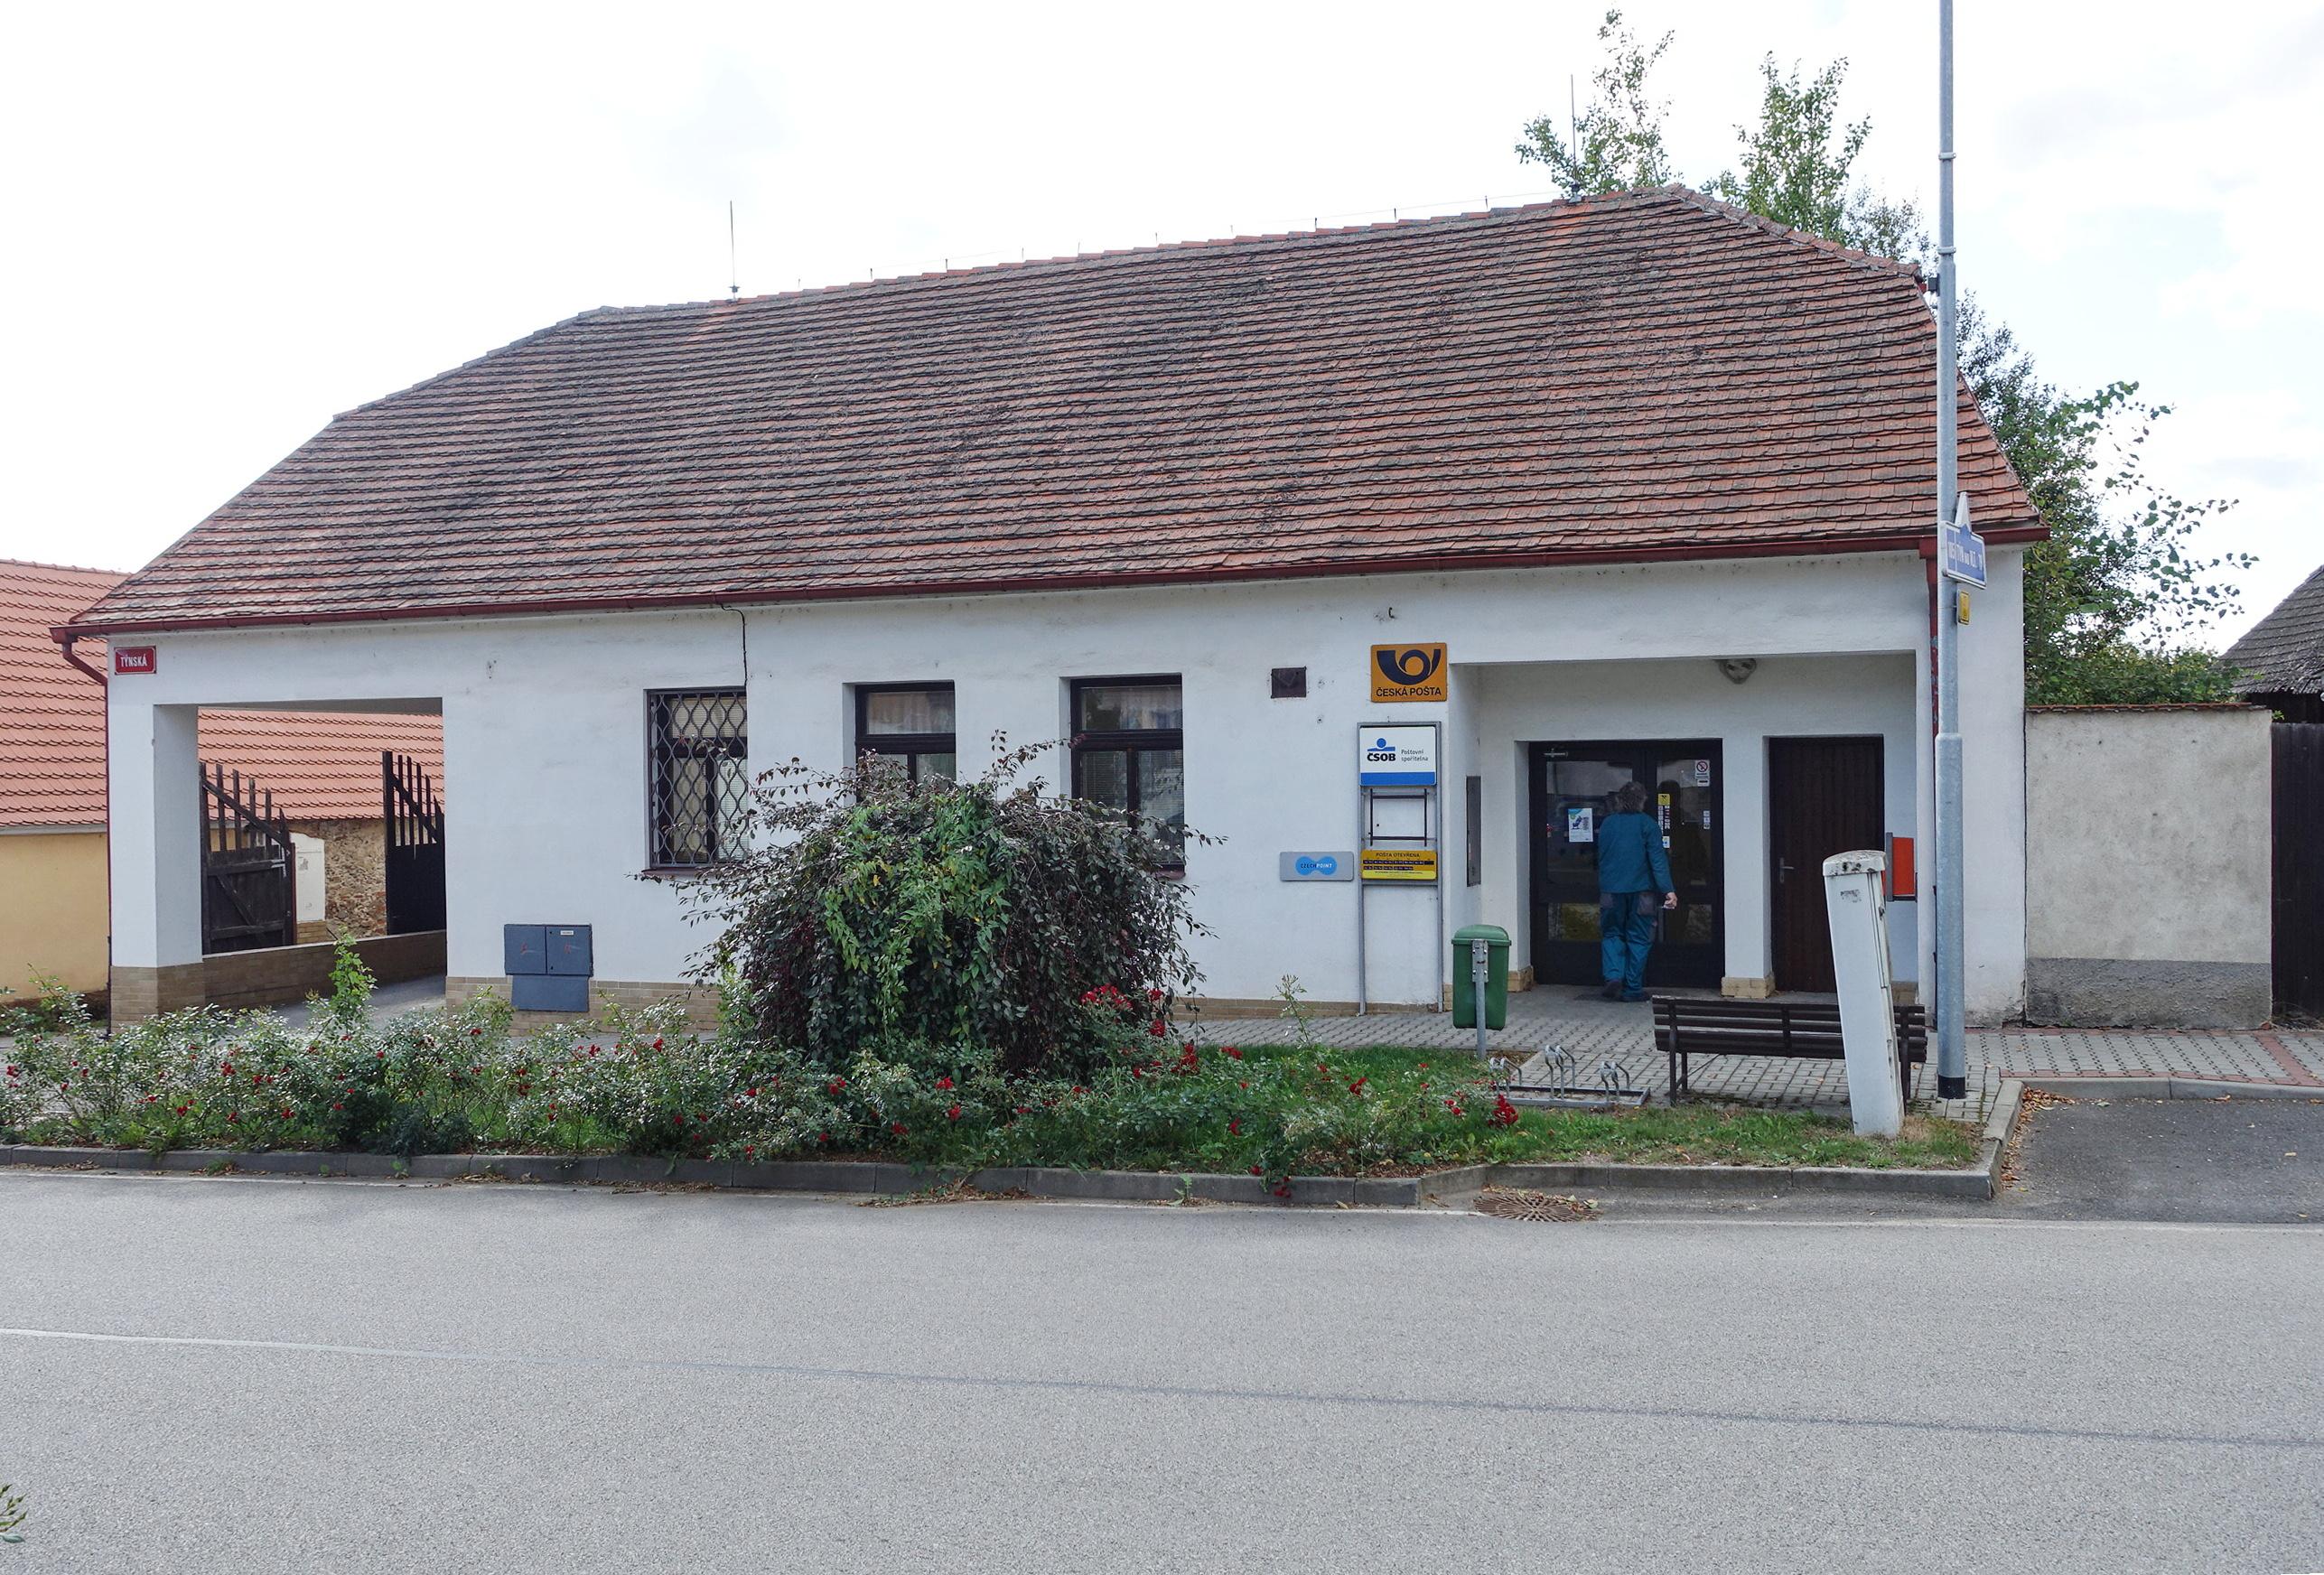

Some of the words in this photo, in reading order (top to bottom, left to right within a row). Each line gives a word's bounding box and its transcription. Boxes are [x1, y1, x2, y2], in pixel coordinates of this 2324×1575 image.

[120, 653, 148, 667] TÝNSKÁ
[1376, 686, 1407, 697] ČESKÁ
[1410, 685, 1442, 696] POŠTA
[1367, 752, 1396, 762] ČSOB
